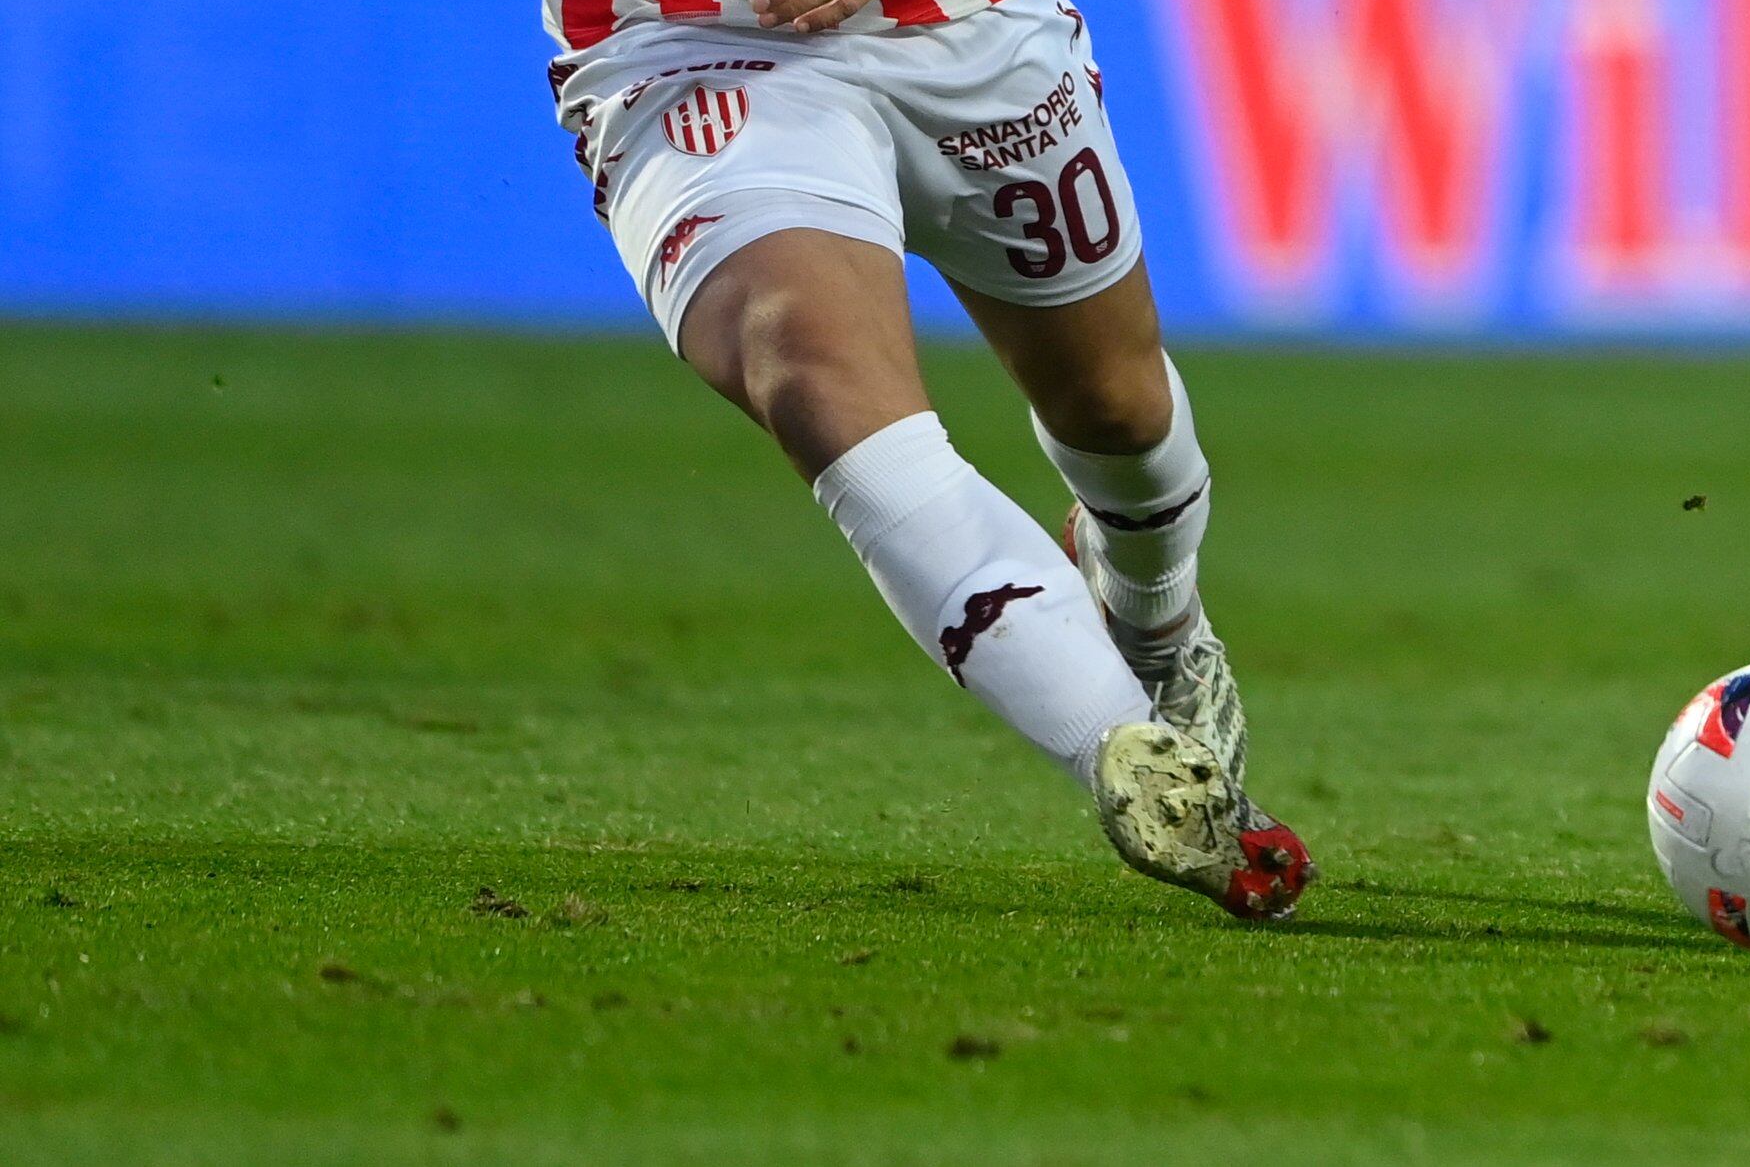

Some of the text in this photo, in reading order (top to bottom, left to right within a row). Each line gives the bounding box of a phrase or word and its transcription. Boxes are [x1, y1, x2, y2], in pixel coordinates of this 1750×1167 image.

[937, 71, 1076, 156] SANATORIO
[959, 99, 1083, 171] SANTA FE
[993, 146, 1120, 279] 30
